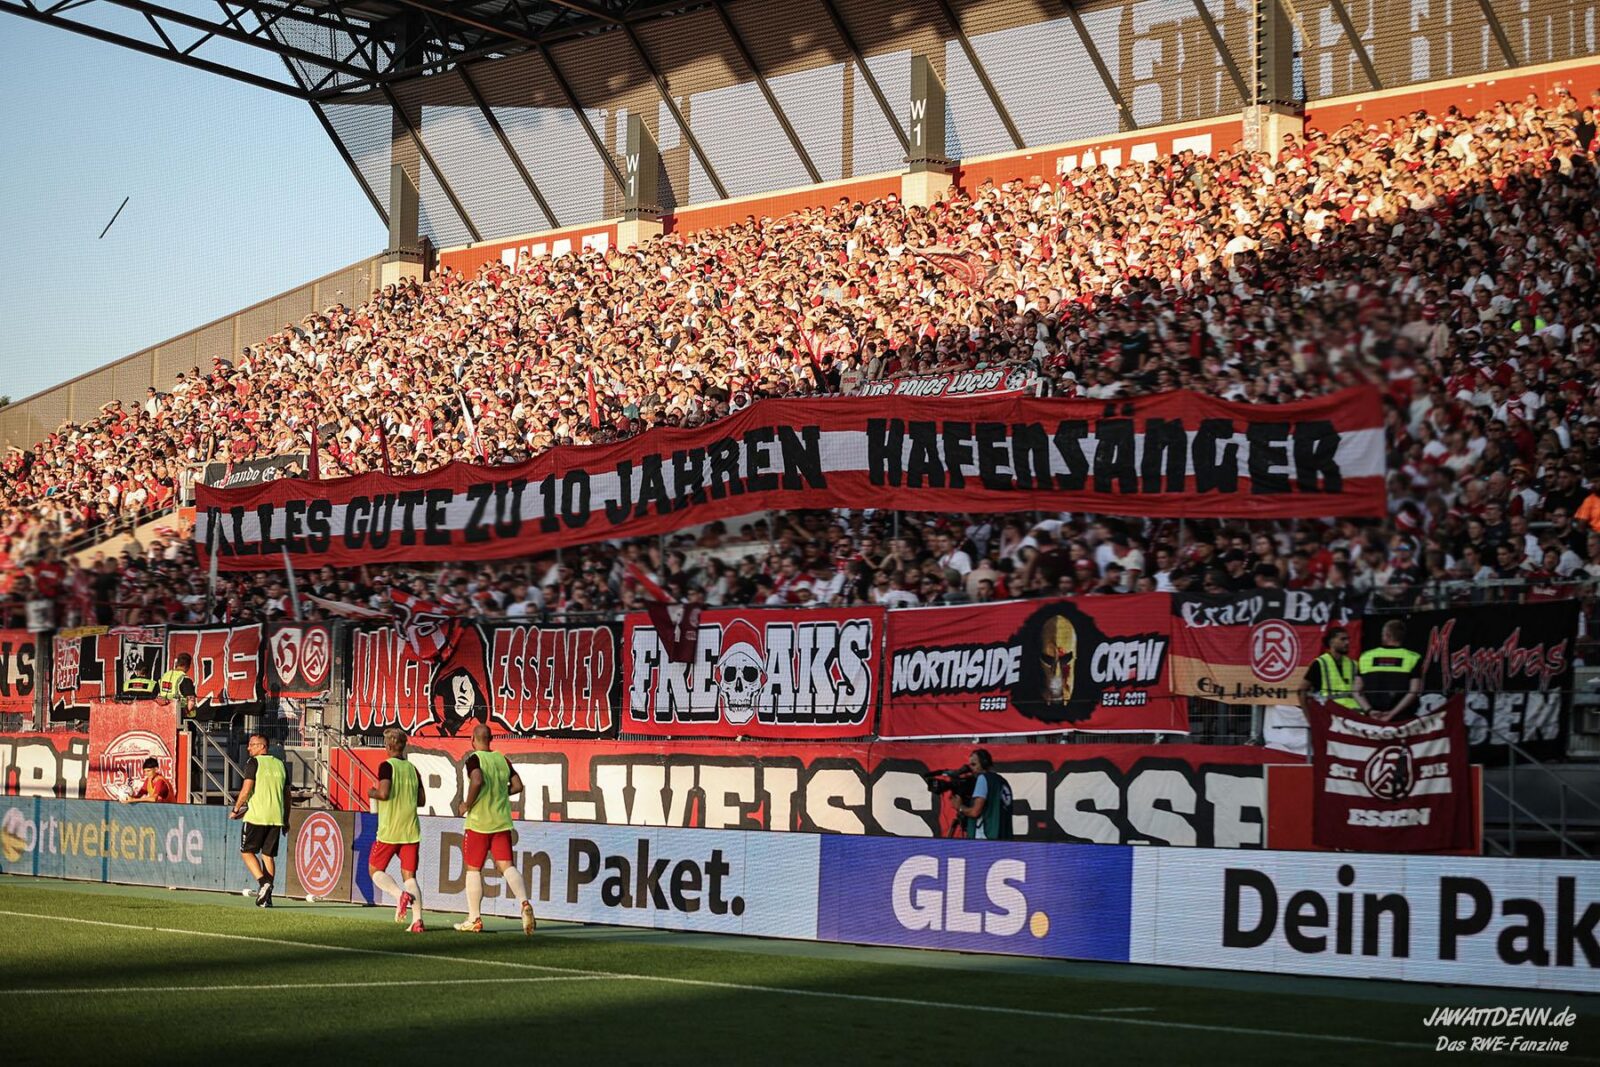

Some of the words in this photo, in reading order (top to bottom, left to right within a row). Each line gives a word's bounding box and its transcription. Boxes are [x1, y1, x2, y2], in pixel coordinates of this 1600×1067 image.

[910, 98, 927, 120] W
[913, 122, 921, 146] 1
[626, 153, 640, 173] W
[628, 175, 635, 197] 1
[947, 371, 1005, 393] LOCOS
[204, 498, 332, 557] ALLES
[344, 488, 453, 550] GUTE
[465, 479, 528, 543] ZU
[539, 469, 591, 533] 10
[605, 426, 827, 525] JAHREN
[867, 403, 1342, 495] HAFENSÄNGER
[346, 626, 432, 730] JUNGE
[491, 626, 614, 732] ESSENER
[630, 618, 872, 724] FREAKS
[891, 645, 1022, 694] NORTHSIDE
[1091, 638, 1168, 684] CREW
[1419, 618, 1568, 695] Mambas
[1347, 808, 1431, 827] ESSEN
[567, 838, 745, 916] Paket.
[1222, 864, 1410, 958] Dein
